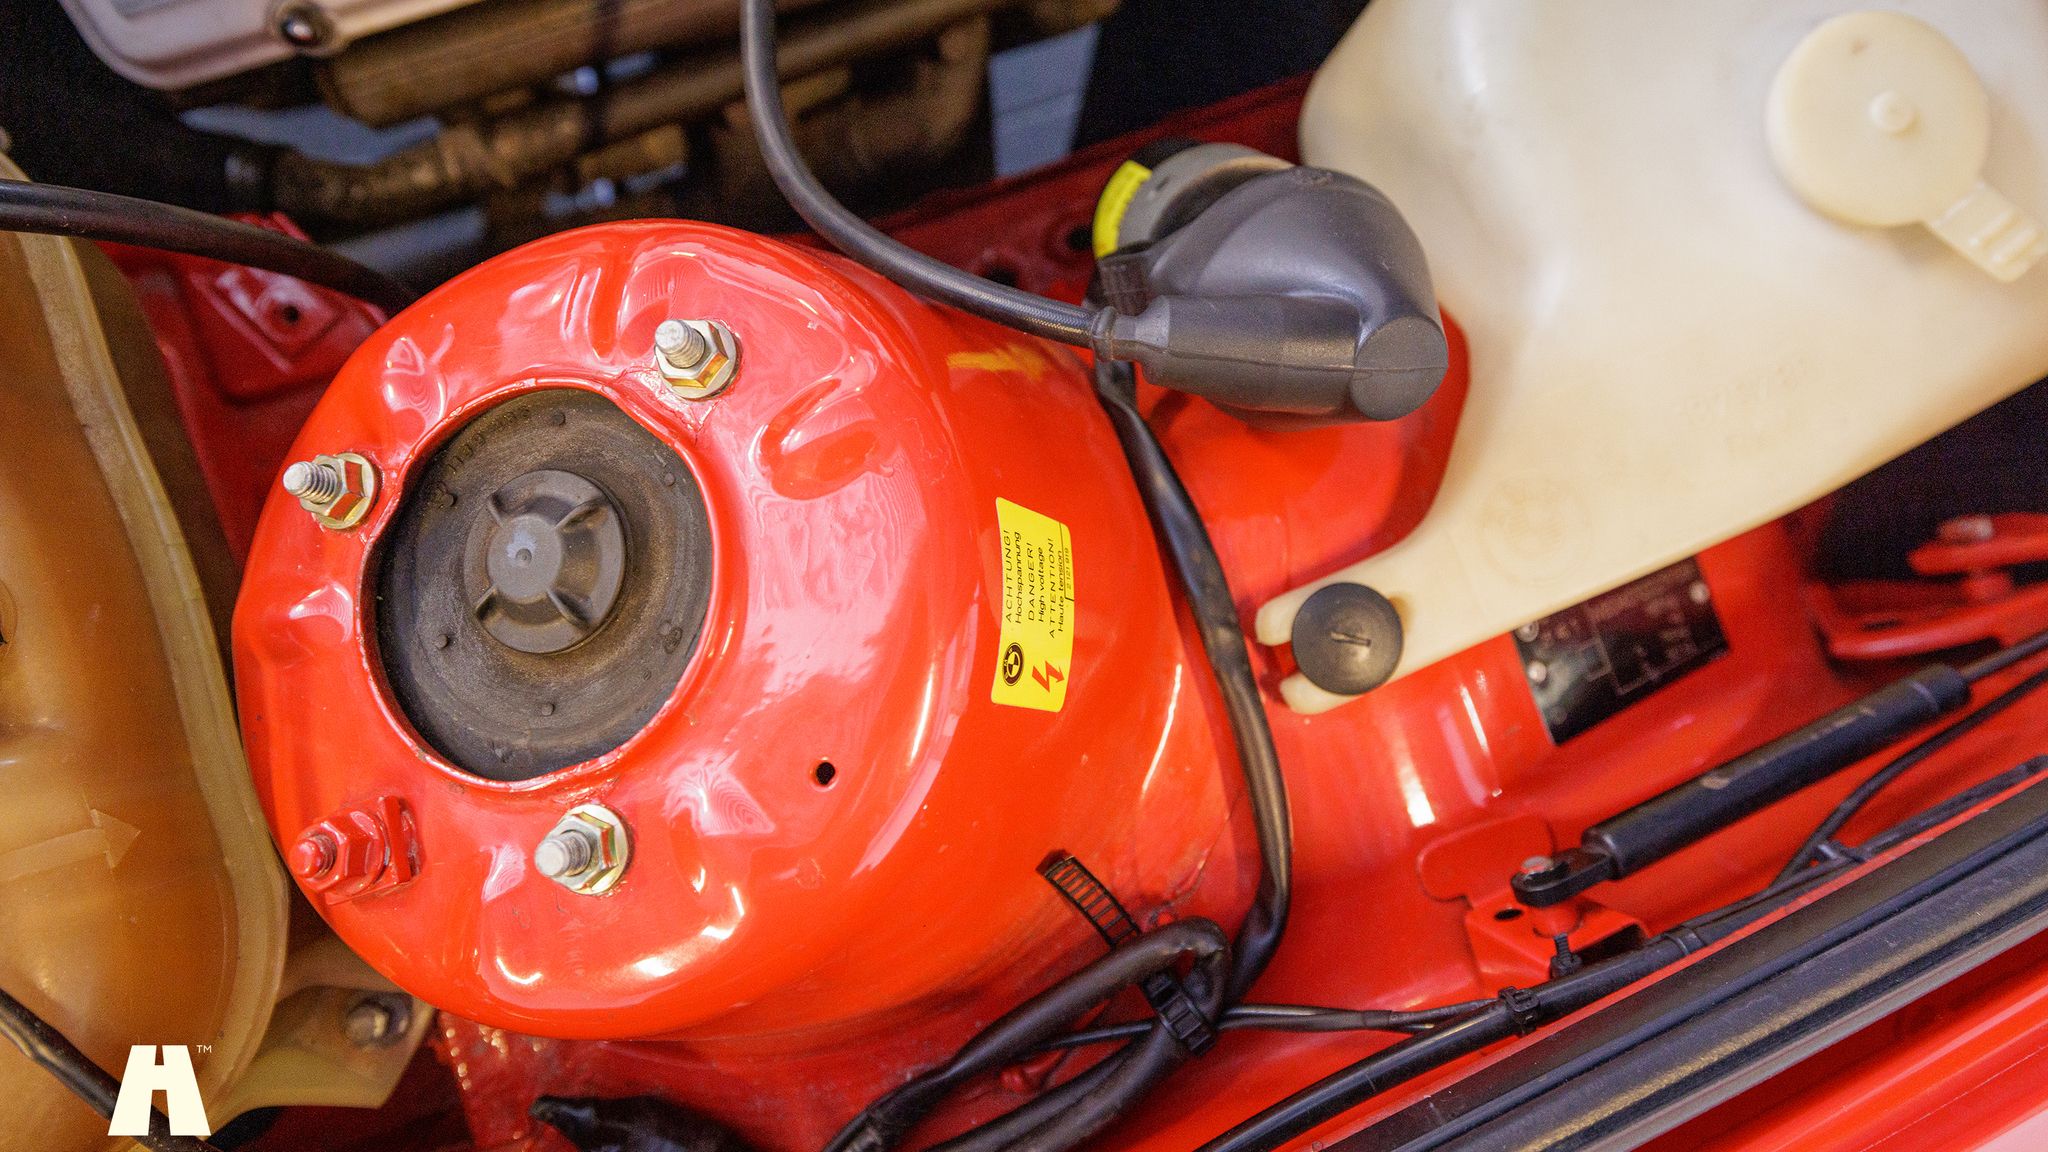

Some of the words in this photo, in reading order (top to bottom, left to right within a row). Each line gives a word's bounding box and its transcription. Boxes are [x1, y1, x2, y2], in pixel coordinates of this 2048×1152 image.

[1003, 530, 1013, 623] ACHTUNG!
[1014, 531, 1023, 624] Hochspannung
[1026, 542, 1035, 621] DANGER!
[1037, 547, 1045, 591] voltage
[1038, 595, 1046, 622] High
[1047, 538, 1057, 638] ATTENTION!
[1057, 550, 1065, 591] tension
